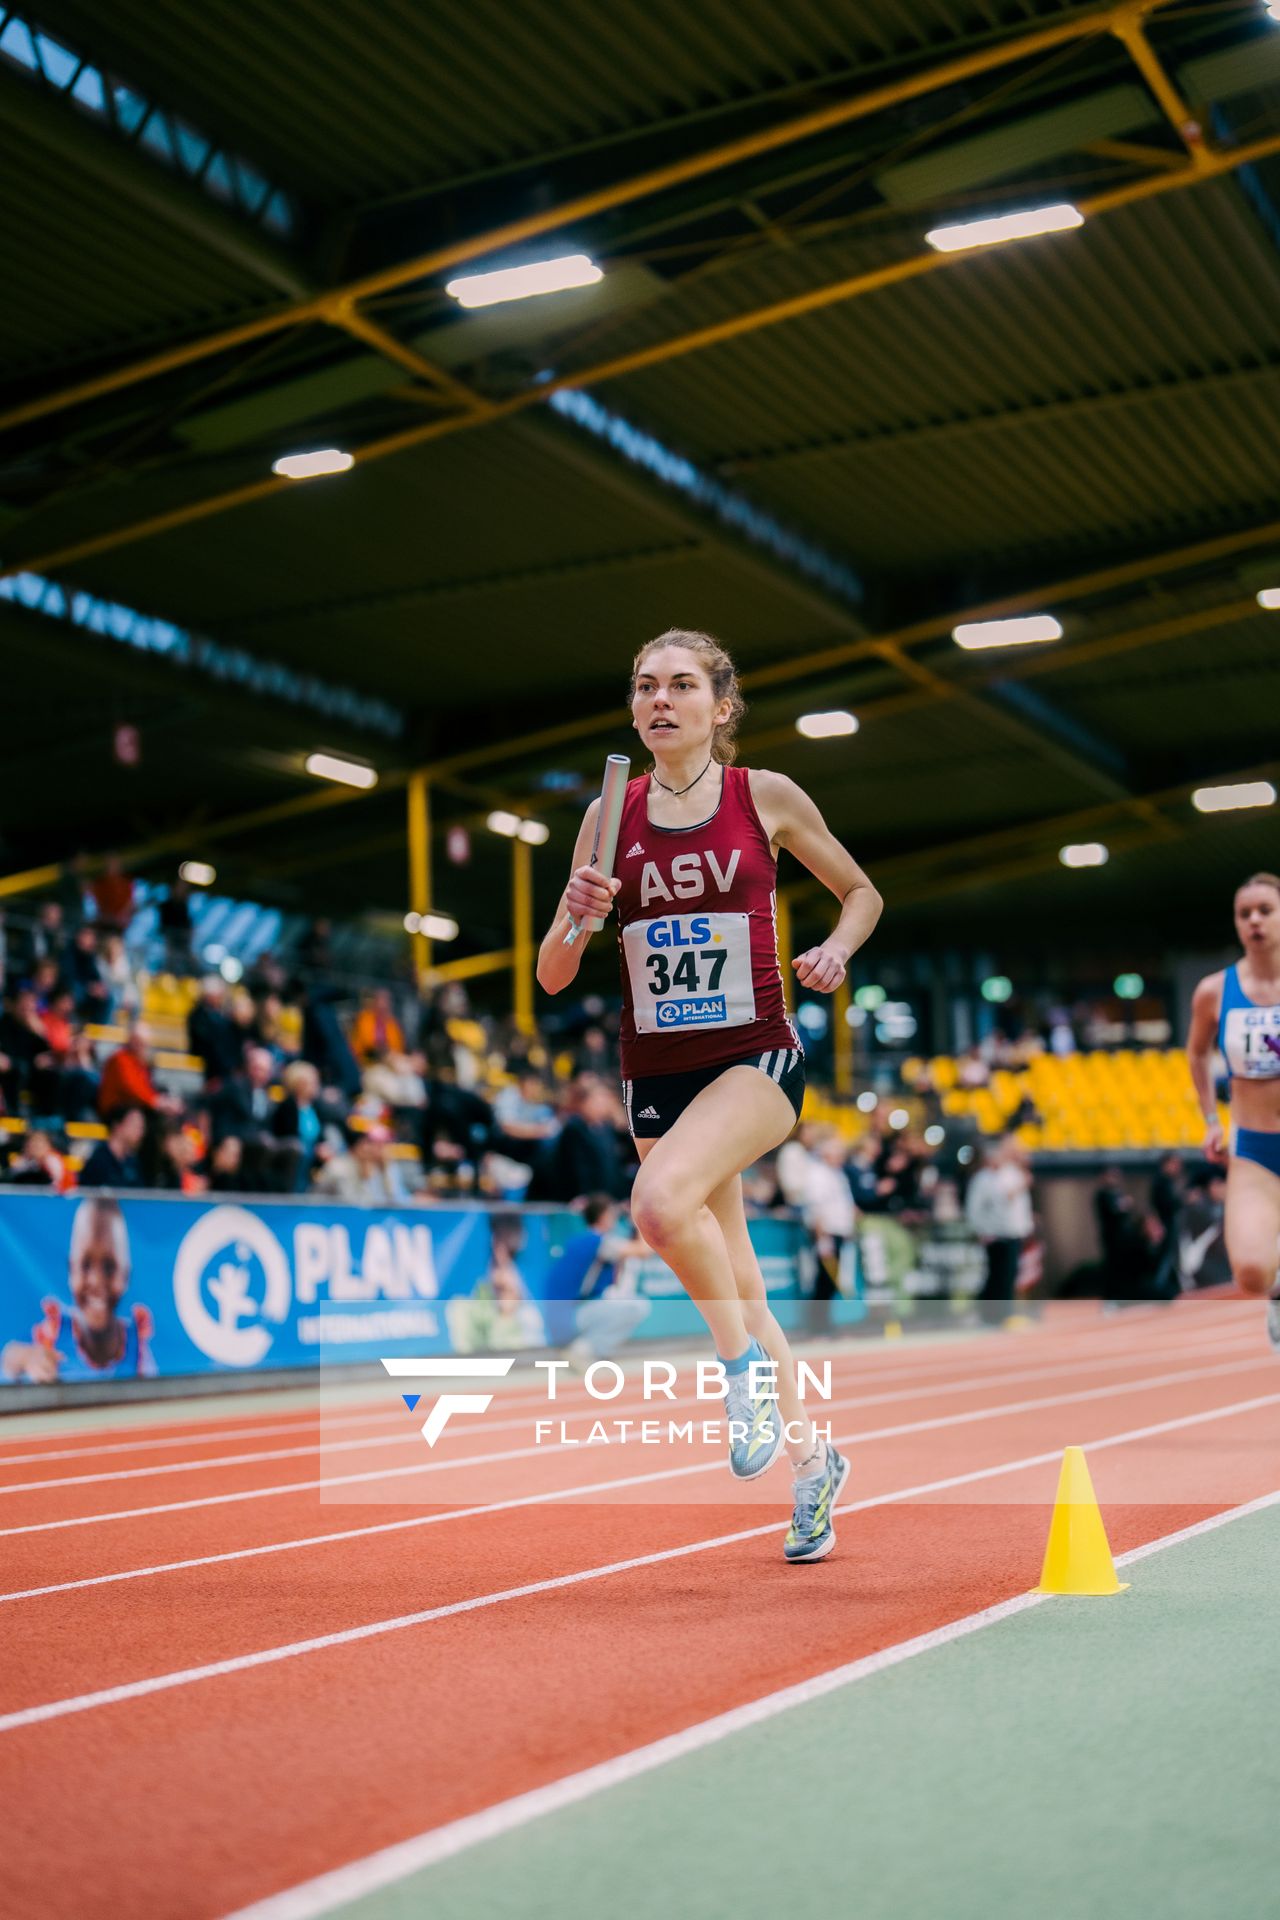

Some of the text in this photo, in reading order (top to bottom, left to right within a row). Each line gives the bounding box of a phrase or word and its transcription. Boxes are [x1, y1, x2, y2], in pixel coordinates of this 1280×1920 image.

[641, 849, 742, 908] ASV
[646, 949, 728, 996] 347
[682, 1001, 723, 1015] PLAN
[293, 1222, 439, 1304] PLAN
